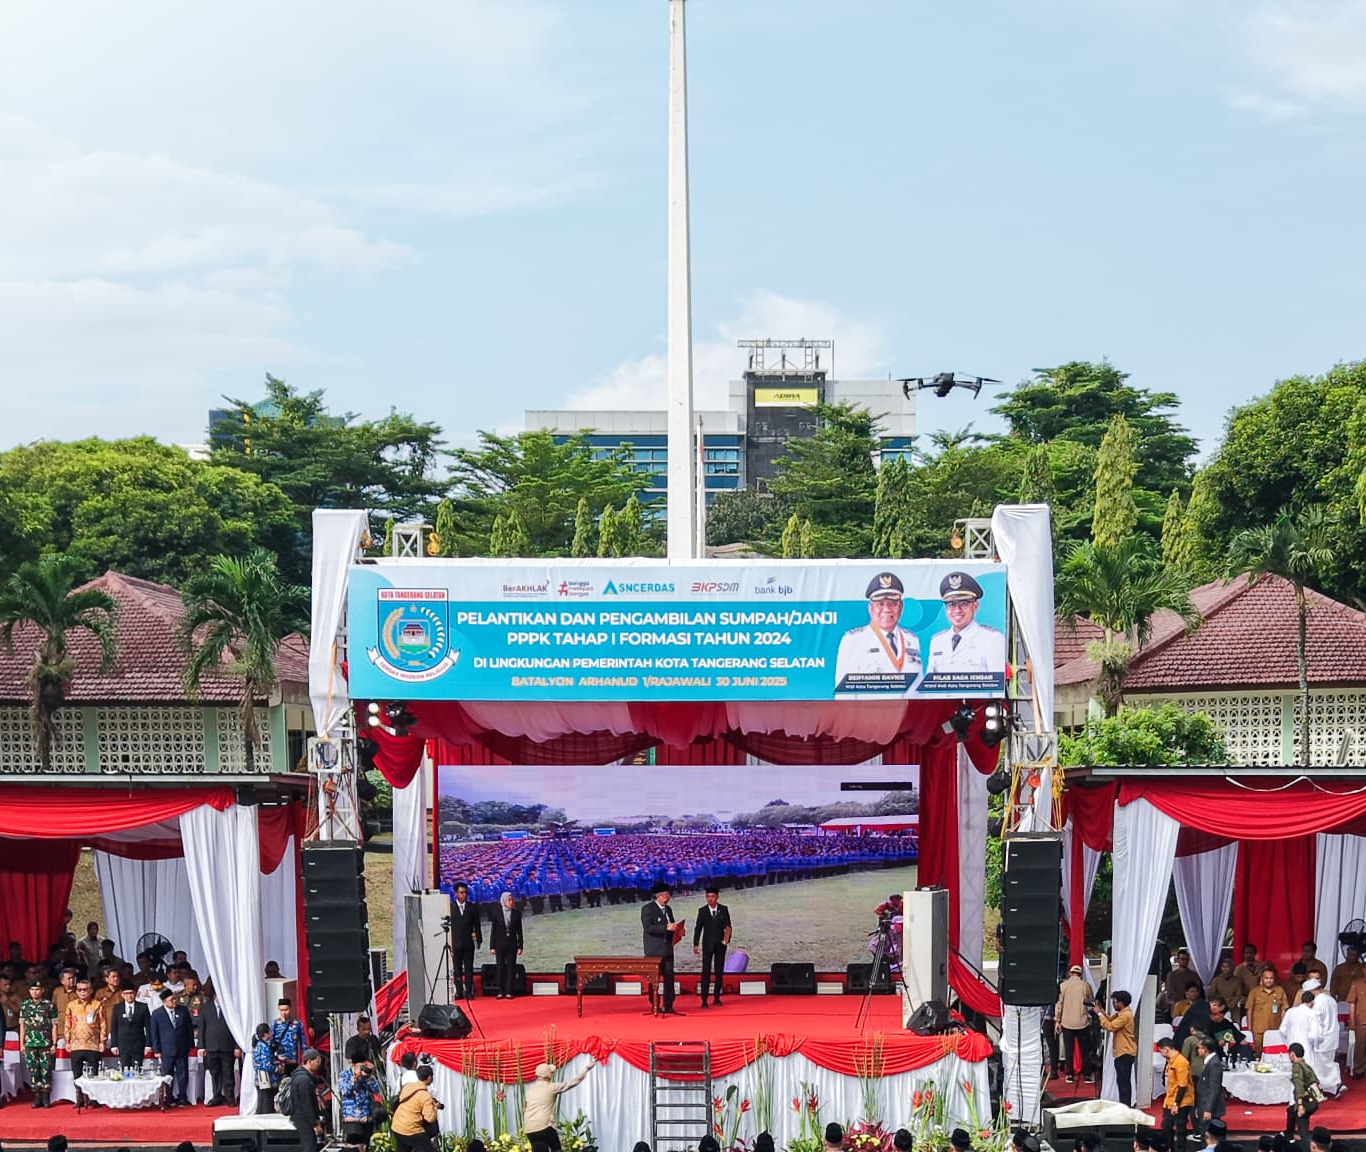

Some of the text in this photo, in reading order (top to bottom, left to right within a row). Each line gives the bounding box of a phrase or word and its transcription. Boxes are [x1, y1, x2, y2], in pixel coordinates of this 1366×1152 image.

[381, 591, 445, 599] KOTA TANGERANG SELATAN
[755, 585, 793, 596] bank bjb
[457, 610, 837, 626] PELANTIKAN DAN PENGAMBILAN SUMPAH/JANJI
[507, 632, 792, 645] PPPK TAHAP I FORMASI TAHUN 2024
[473, 657, 825, 668] DI LINGKUNGAN PEMERINTAH KOTA TANGERANG SELATAN
[511, 676, 787, 688] BATALYON ARHANUD 1/RAJAWALI 30 JUNI 2025
